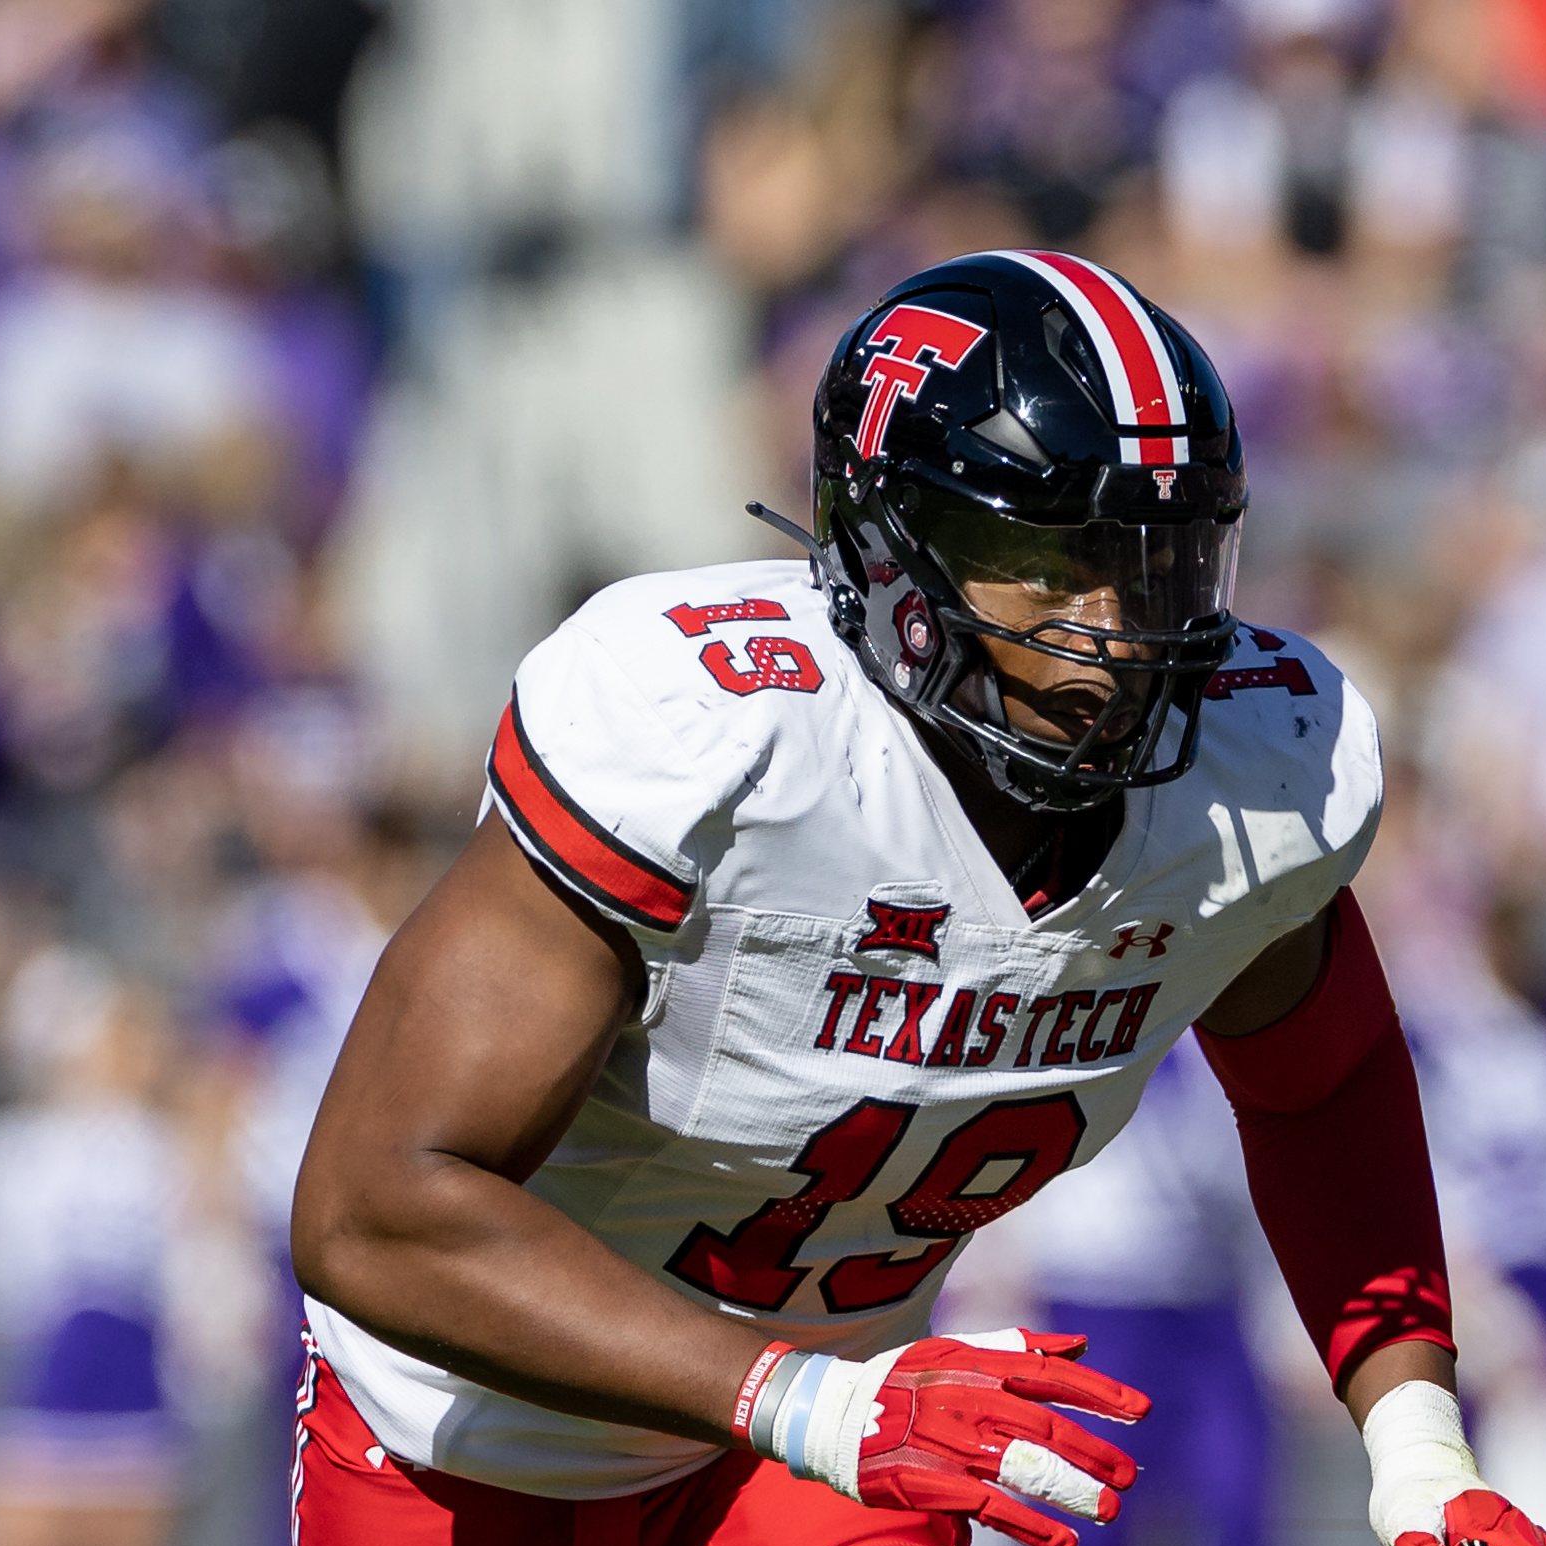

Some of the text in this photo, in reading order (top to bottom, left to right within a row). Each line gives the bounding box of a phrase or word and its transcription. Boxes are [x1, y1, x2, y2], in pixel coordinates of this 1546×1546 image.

[661, 597, 825, 697] 19
[814, 972, 1162, 1068] TEXAS TECH
[663, 1090, 1087, 1315] 19
[734, 1350, 778, 1428] RED RAIDERS
